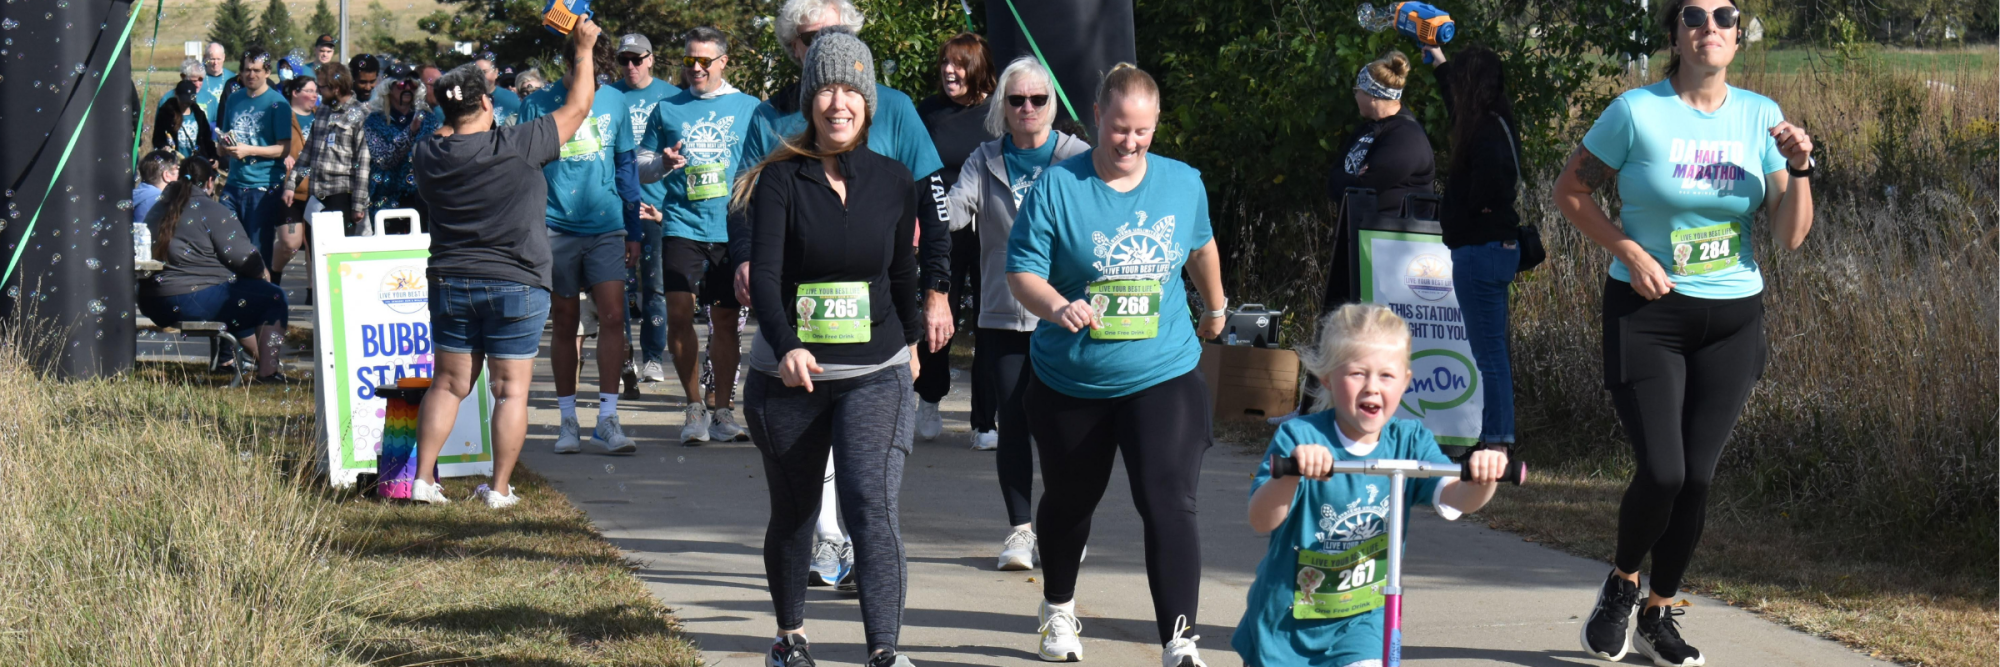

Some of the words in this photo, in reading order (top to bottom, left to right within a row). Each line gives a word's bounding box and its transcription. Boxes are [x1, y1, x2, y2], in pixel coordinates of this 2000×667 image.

[1694, 149, 1724, 164] HALF
[1672, 164, 1746, 181] MARATHON
[1694, 232, 1708, 240] YOUR
[1709, 230, 1721, 238] BEST
[1722, 228, 1733, 236] LIFE
[1699, 239, 1730, 261] 284
[1105, 266, 1119, 275] LIVE
[1121, 265, 1138, 274] YOUR
[1140, 264, 1156, 273] BEST
[1156, 263, 1169, 273] LIFE
[1112, 284, 1127, 292] YOUR
[1128, 284, 1141, 292] BEST
[1142, 284, 1152, 292] LIFE
[824, 298, 858, 318] 265
[1117, 296, 1149, 315] 268
[1389, 303, 1414, 319] THIS
[1416, 305, 1462, 322] STATION
[1408, 323, 1428, 339] GHT
[1430, 324, 1444, 339] TO
[1405, 366, 1466, 394] mOn
[1325, 541, 1341, 550] LIVE
[1311, 557, 1328, 566] LIVE
[1331, 556, 1349, 566] YOUR
[1366, 543, 1379, 555] LIFE
[1337, 559, 1376, 591] 267
[1352, 601, 1371, 611] Drink
